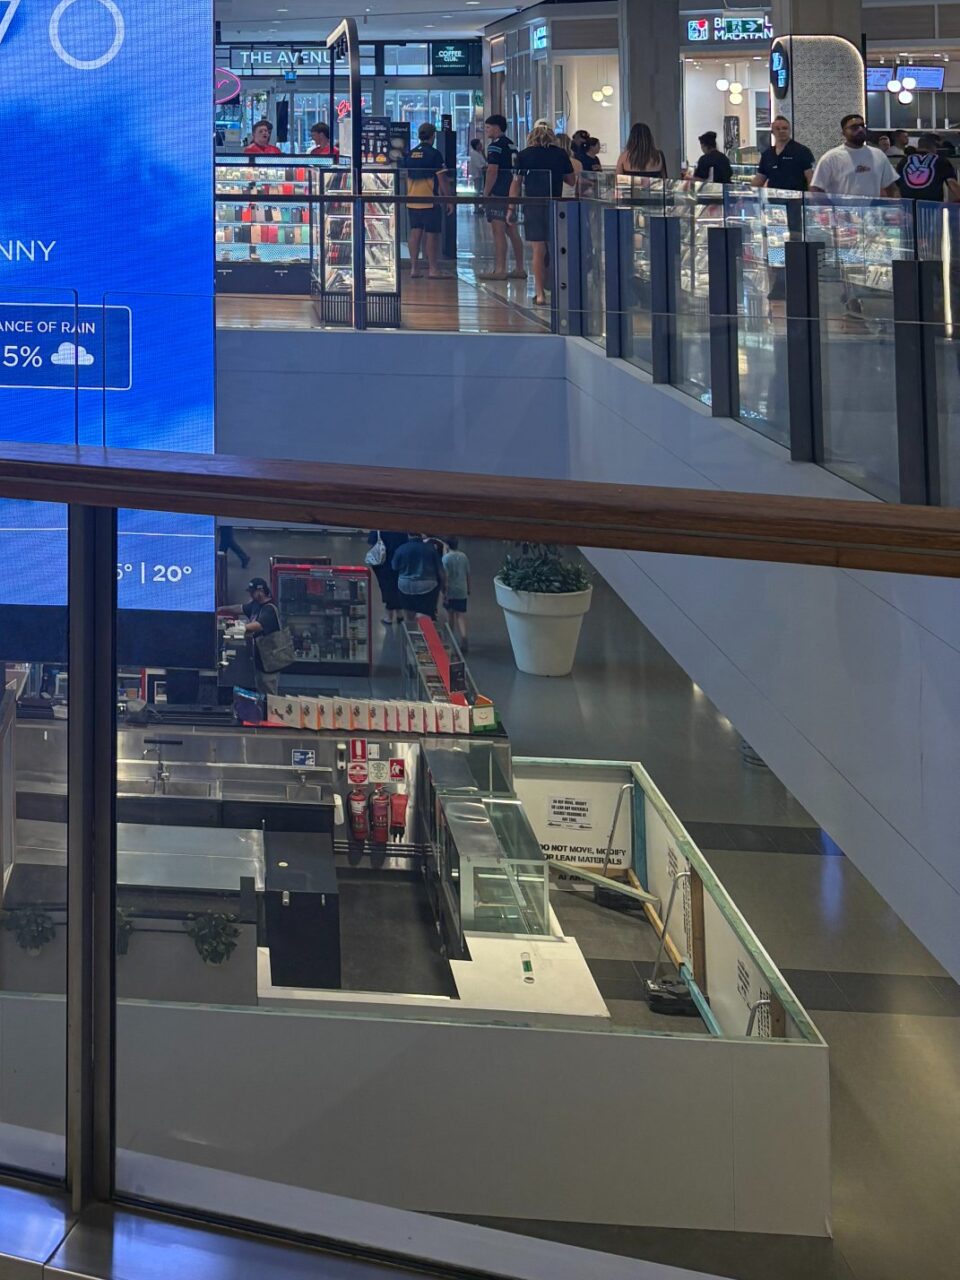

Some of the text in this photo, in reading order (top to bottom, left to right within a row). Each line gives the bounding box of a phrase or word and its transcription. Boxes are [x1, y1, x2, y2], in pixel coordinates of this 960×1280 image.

[240, 51, 344, 63] THE AVENU
[38, 322, 57, 333] OF
[62, 322, 95, 334] RAIN
[2, 346, 42, 367] 5%
[153, 565, 192, 582] 20°
[570, 846, 594, 854] MOVE,
[596, 848, 626, 856] MODIFY
[578, 857, 622, 865] MATERALS
